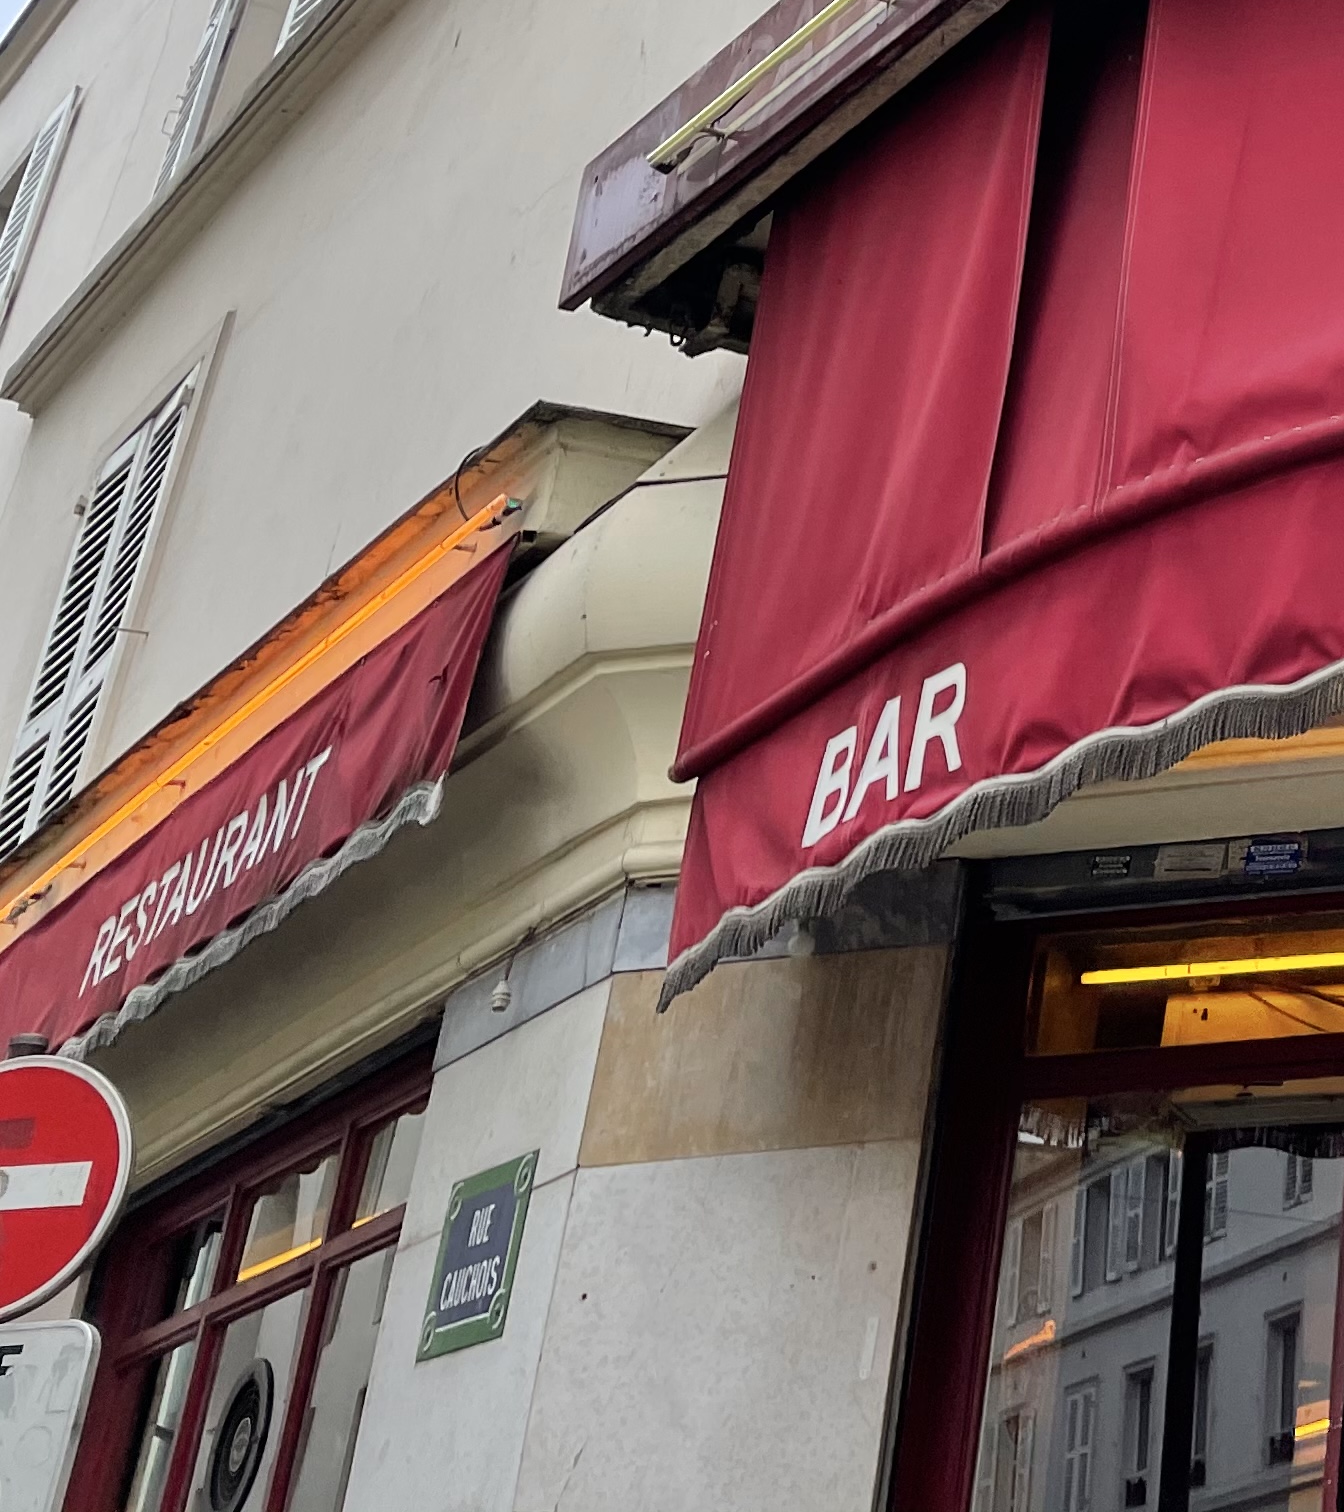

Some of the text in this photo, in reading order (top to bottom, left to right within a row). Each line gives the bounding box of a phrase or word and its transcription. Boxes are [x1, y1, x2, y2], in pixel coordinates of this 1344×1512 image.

[801, 661, 967, 849] BAR
[77, 744, 333, 1000] RESTAURANT
[439, 1254, 502, 1312] CAUCHOIS
[467, 1202, 497, 1249] RUE
